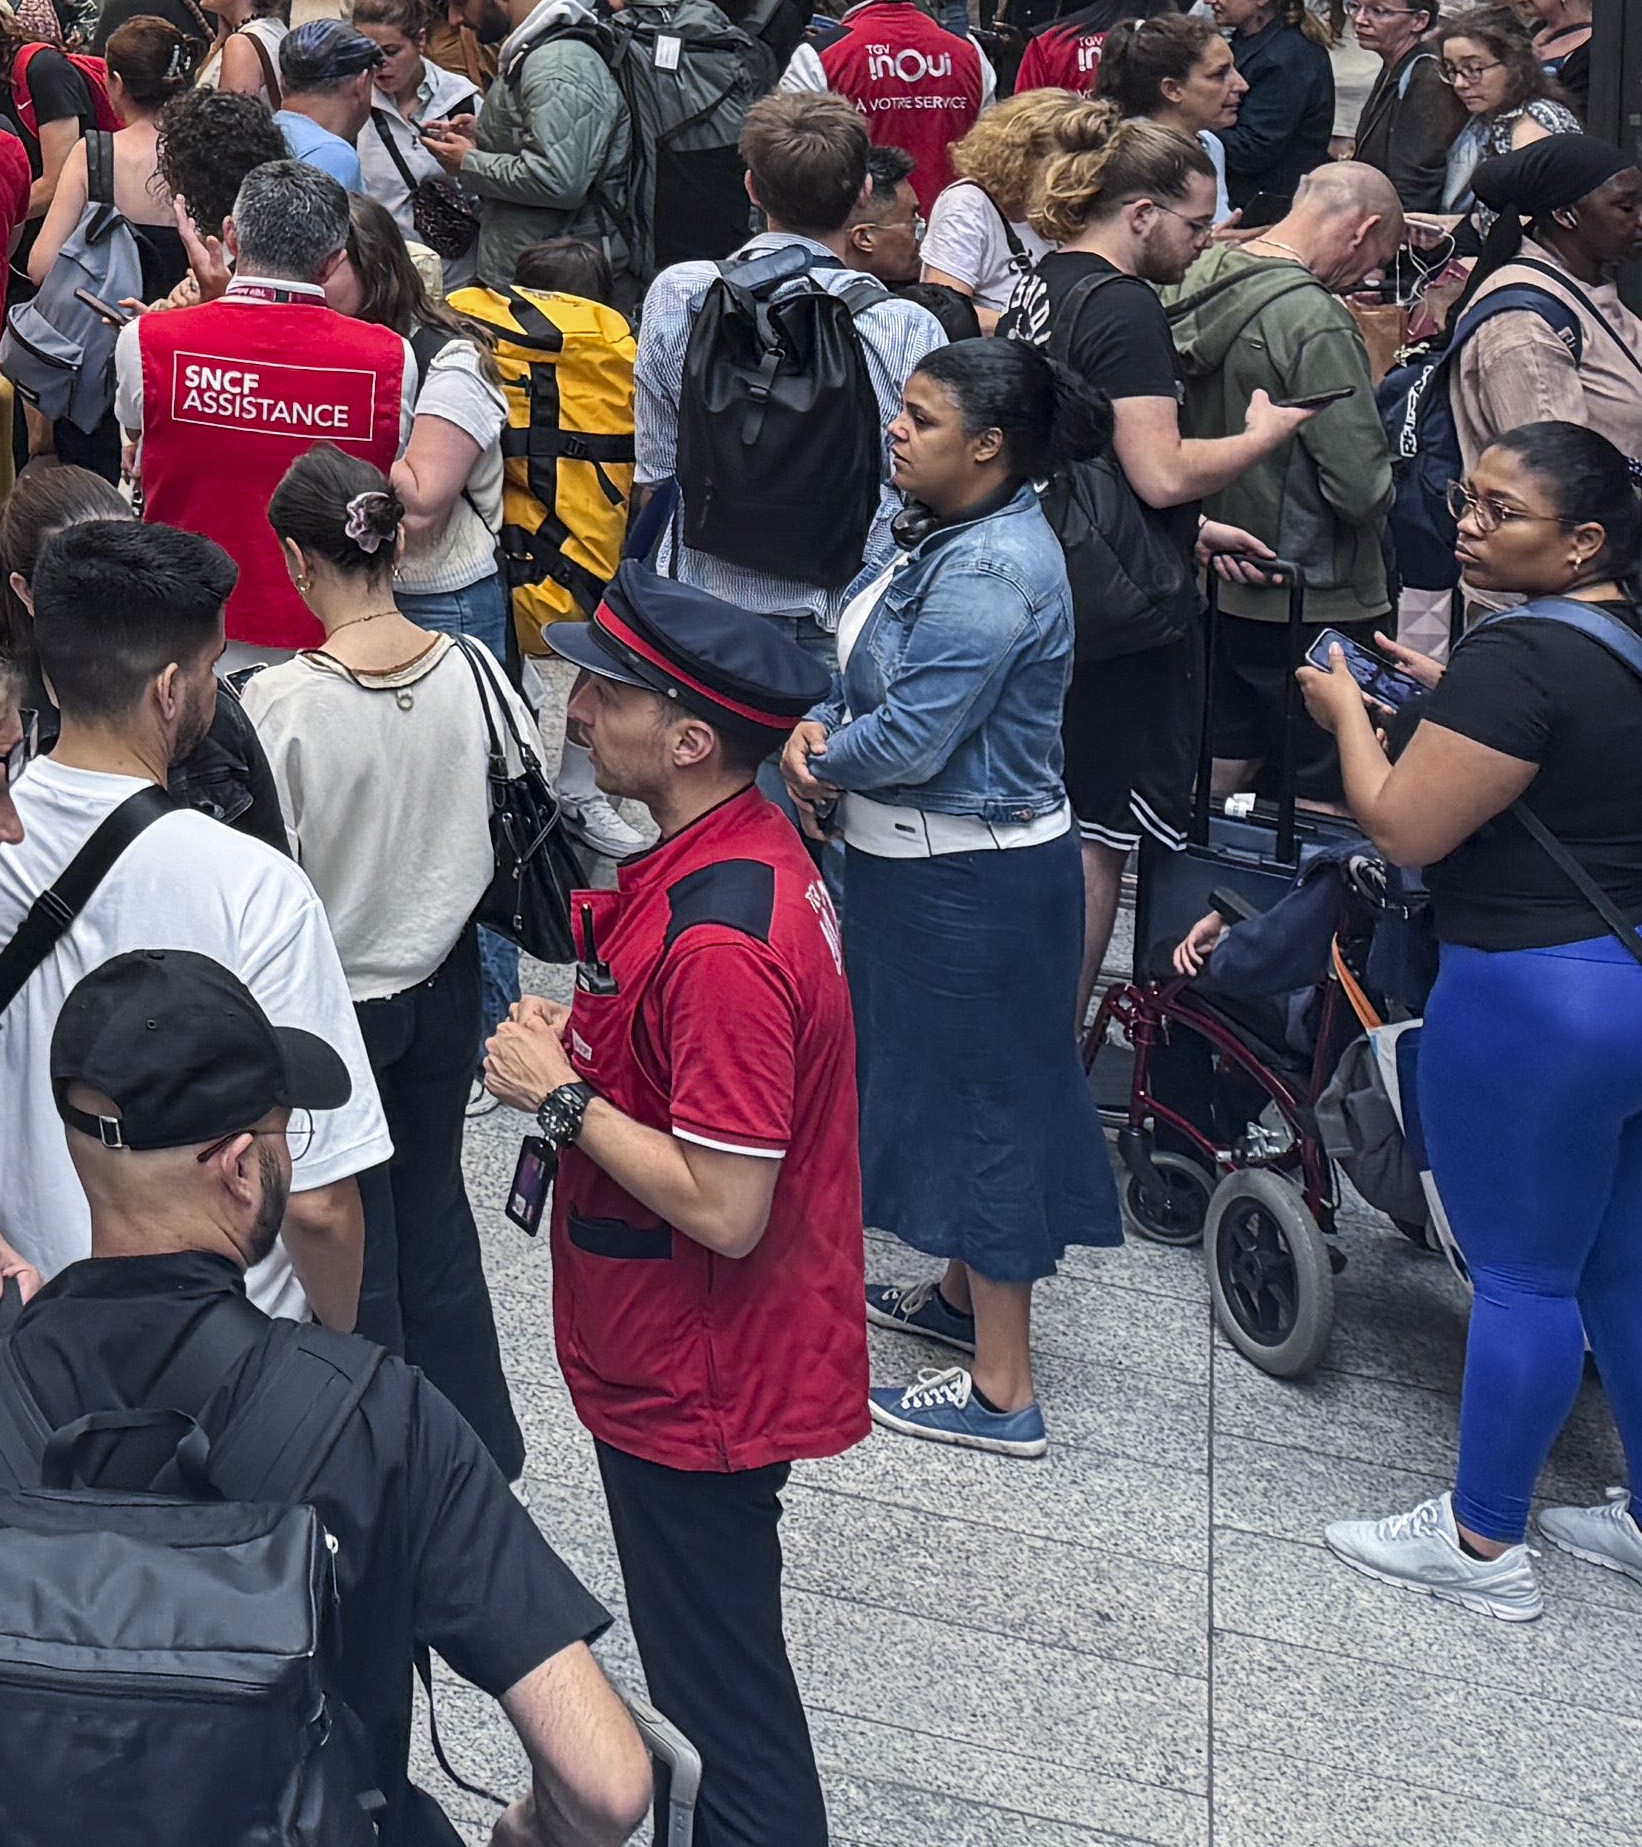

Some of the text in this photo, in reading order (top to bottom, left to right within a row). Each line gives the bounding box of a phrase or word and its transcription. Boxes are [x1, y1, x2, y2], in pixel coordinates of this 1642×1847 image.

[866, 43, 890, 56] TGV
[870, 97, 912, 111] VOTRE
[915, 96, 966, 109] SERVICE
[184, 365, 259, 393] SNCF
[184, 391, 348, 427] ASSISTANCE
